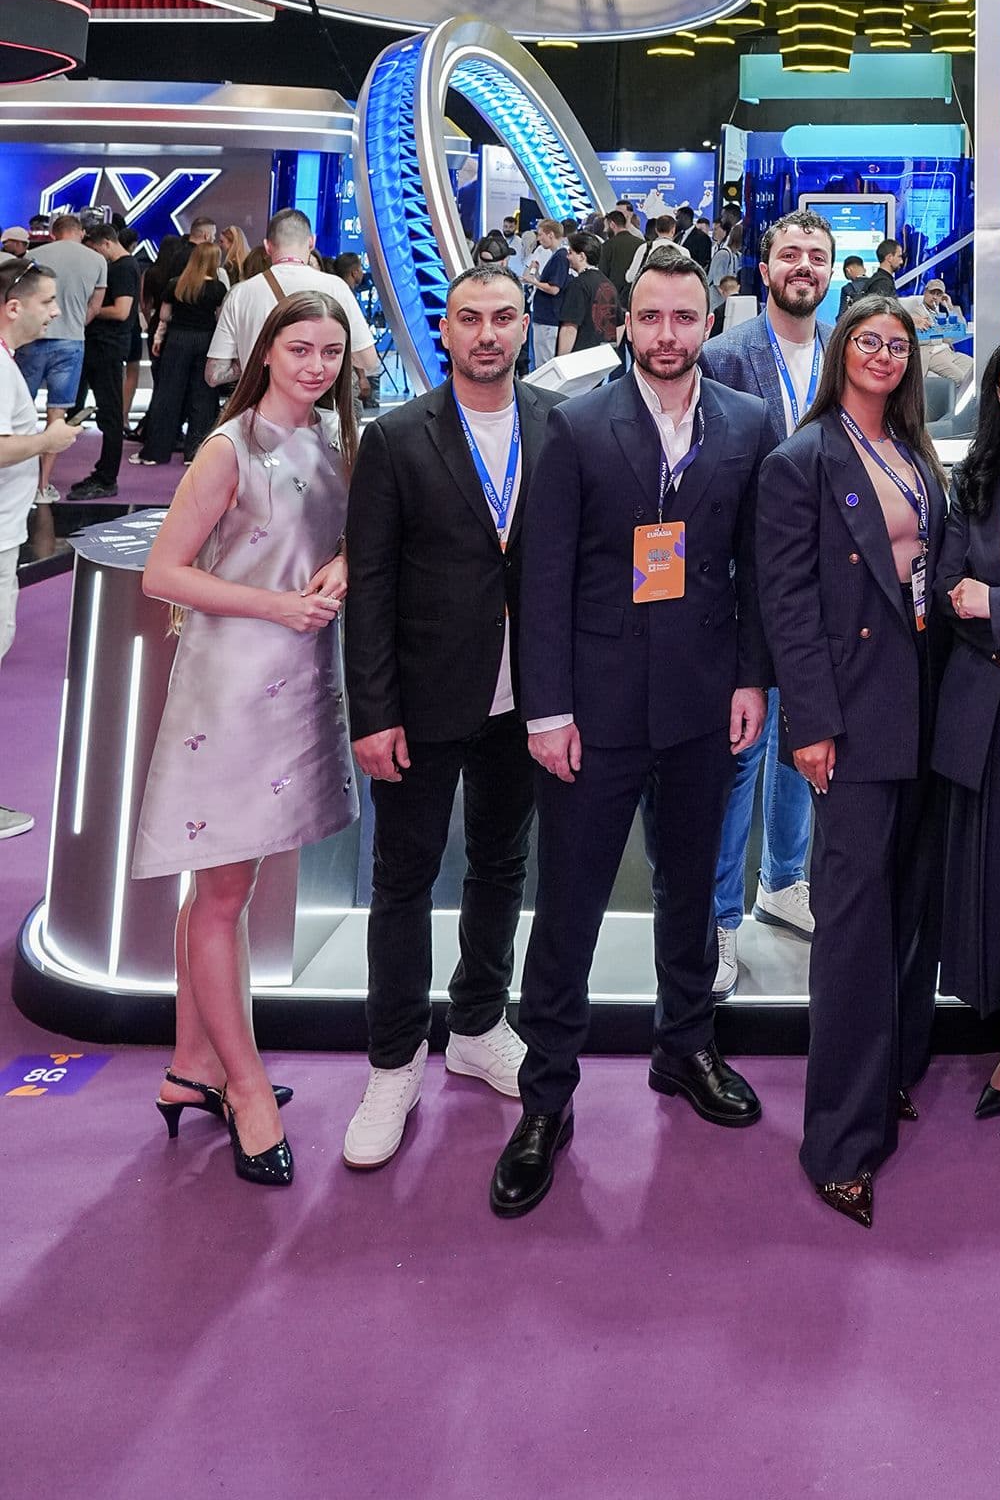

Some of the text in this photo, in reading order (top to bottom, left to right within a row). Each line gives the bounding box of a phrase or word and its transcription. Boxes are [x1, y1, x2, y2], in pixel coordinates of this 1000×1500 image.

[609, 164, 668, 175] VamosPago
[884, 465, 908, 494] DIGITAIN
[23, 1068, 67, 1082] 8G
